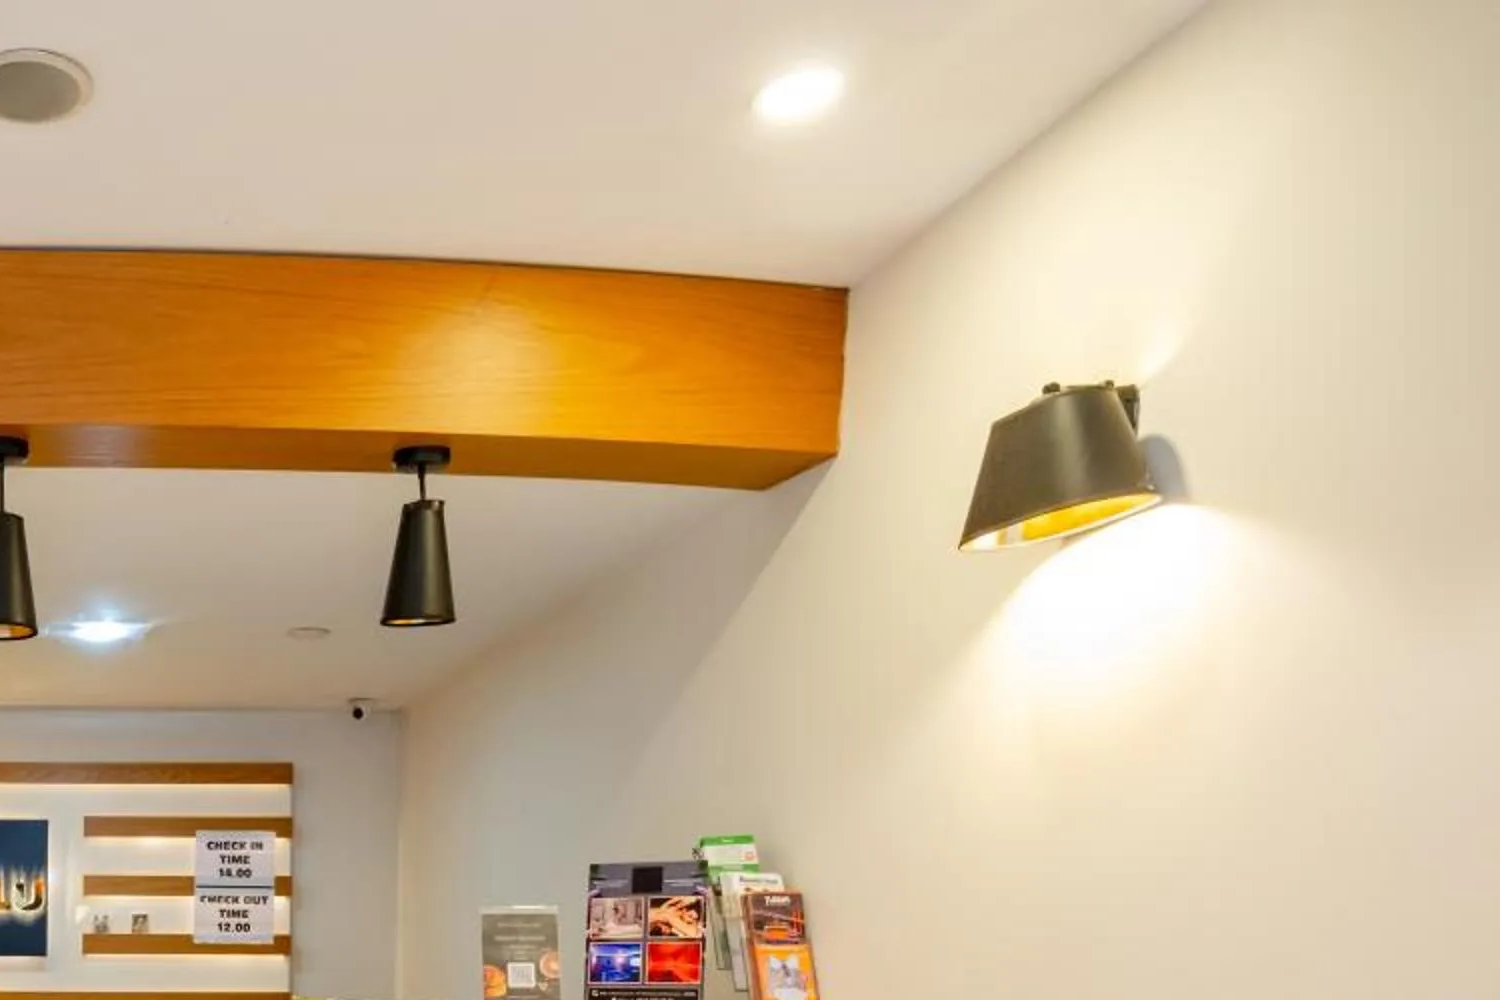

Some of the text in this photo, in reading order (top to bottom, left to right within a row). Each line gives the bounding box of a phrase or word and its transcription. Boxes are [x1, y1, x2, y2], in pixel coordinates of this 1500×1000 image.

[206, 841, 264, 851] CHECK IN
[219, 854, 251, 865] TIME
[200, 895, 269, 905] CHECK OUT
[219, 908, 249, 919] TIME
[217, 922, 251, 933] 12.00
